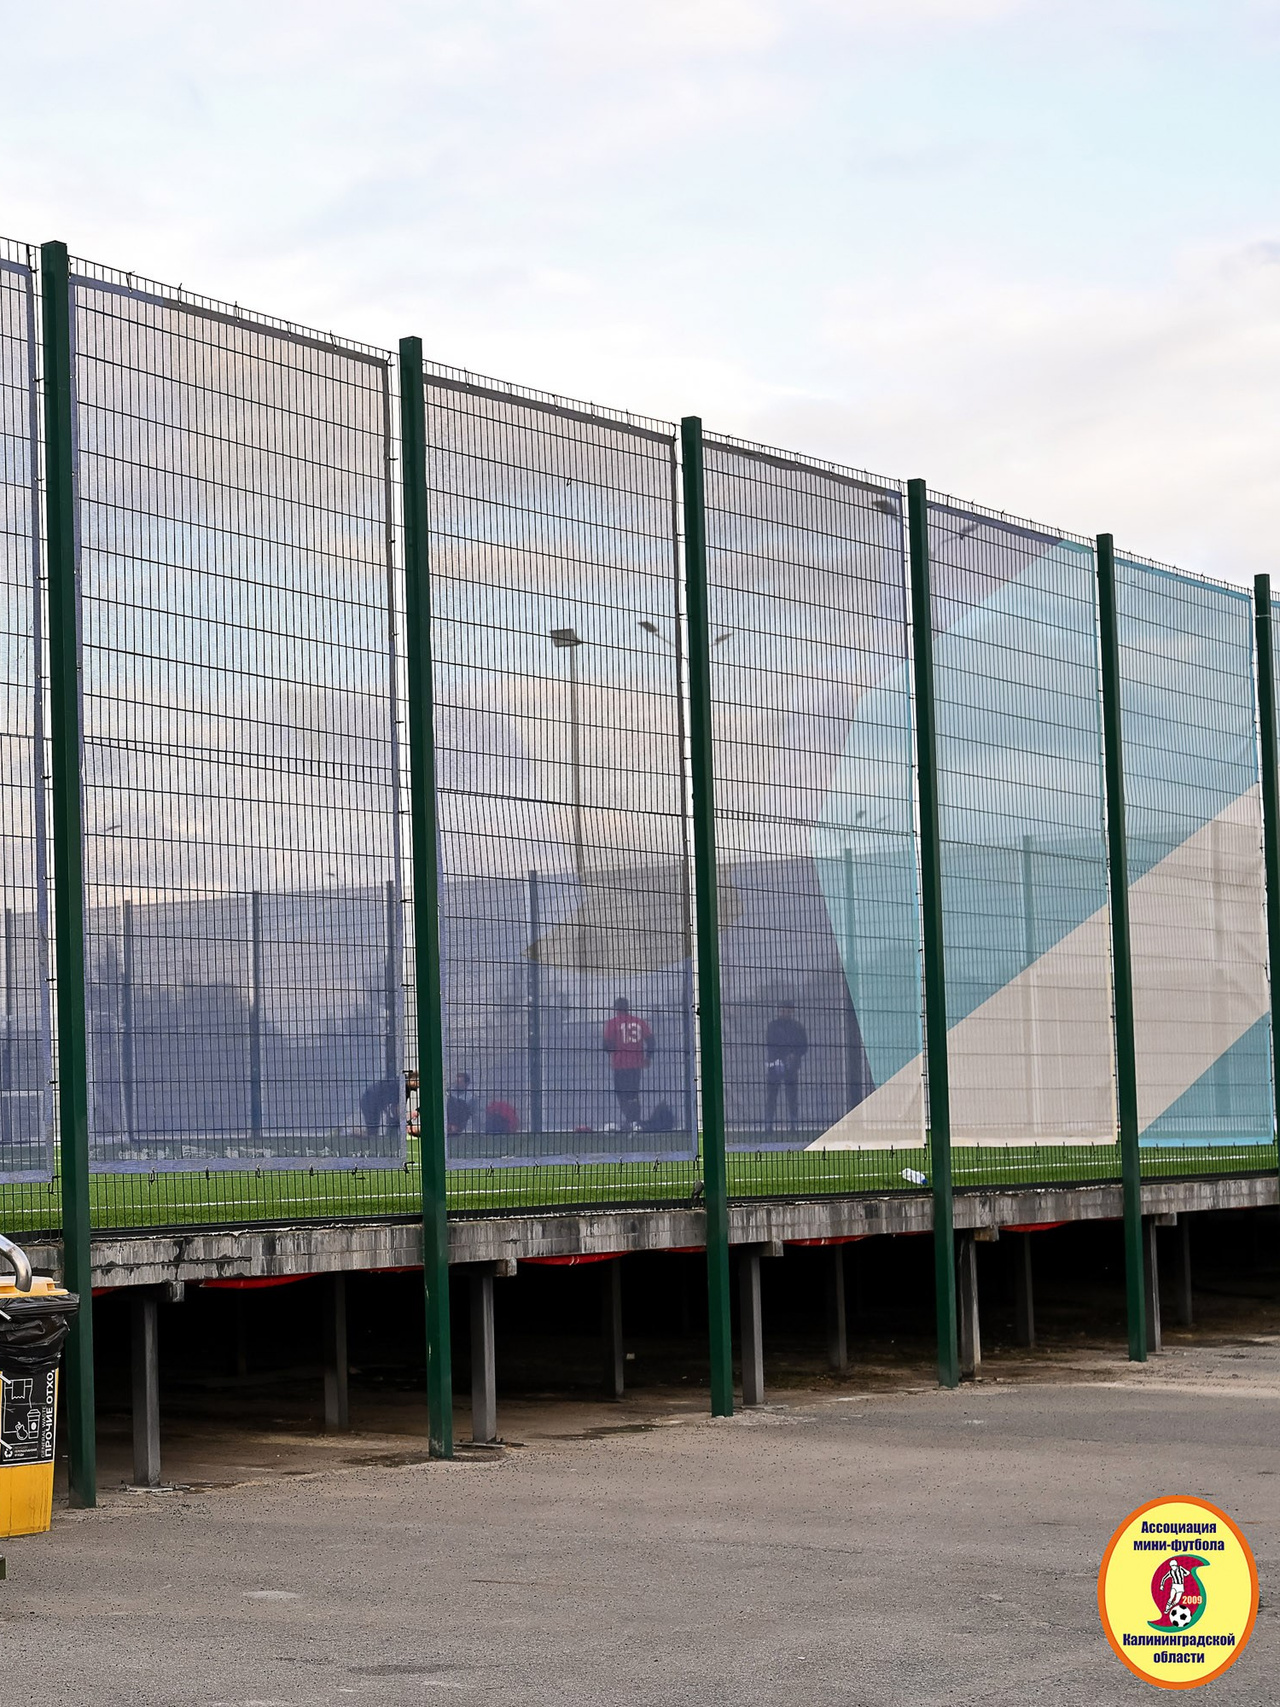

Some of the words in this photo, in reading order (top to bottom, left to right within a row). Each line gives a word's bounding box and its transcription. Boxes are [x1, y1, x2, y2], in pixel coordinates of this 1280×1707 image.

[620, 1022, 642, 1044] 13
[46, 1369, 55, 1405] ОТХО
[45, 1406, 53, 1457] ПРОЧИЕ
